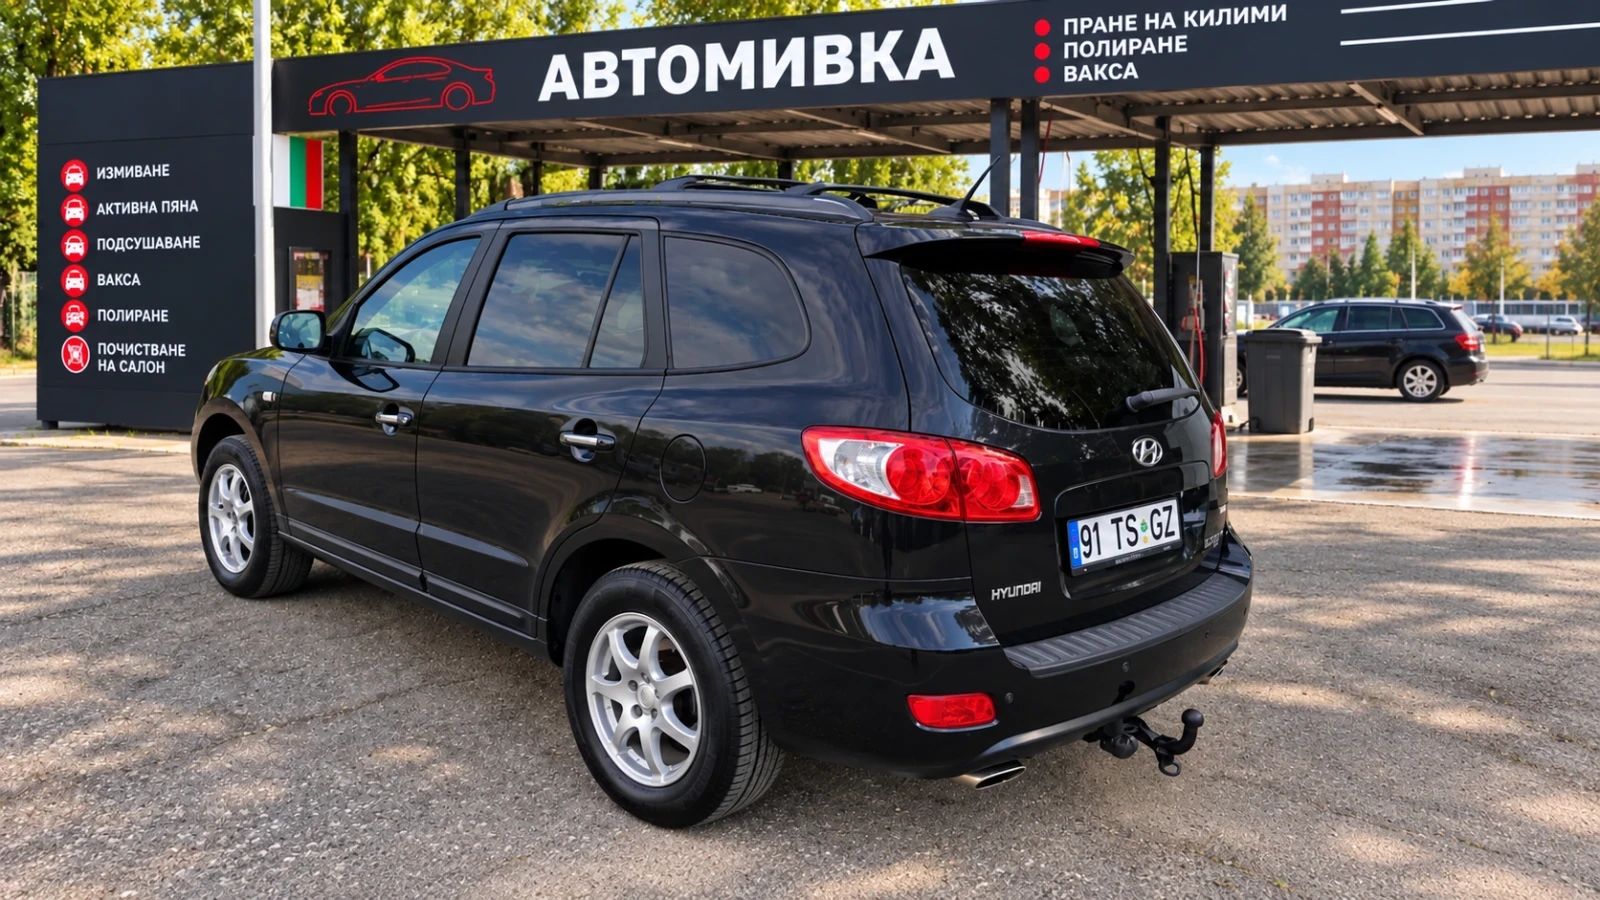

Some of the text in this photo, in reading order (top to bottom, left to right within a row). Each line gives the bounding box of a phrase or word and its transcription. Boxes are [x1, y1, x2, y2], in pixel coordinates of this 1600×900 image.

[1063, 4, 1288, 36] ПРАНЕ НА КИЛИМИ
[1063, 34, 1188, 60] ПОЛИРАНЕ
[537, 27, 956, 102] АВТОМИВКА
[1063, 61, 1139, 83] ВАКСА
[96, 163, 170, 180] ИЗМИВАНЕ
[96, 199, 199, 216] АКТИВНА ПЯНА
[96, 235, 201, 253] ПОДСУШАВАНЕ
[97, 272, 141, 287] ВАКСА
[97, 308, 169, 323] ПОЛИРАНЕ
[97, 342, 186, 357] ПОЧИСТВАНЕ
[97, 358, 165, 374] НА САЛОН
[1080, 521, 1101, 559] 91
[1110, 513, 1139, 550] TS
[1150, 504, 1176, 541] GZ
[991, 581, 1042, 601] HYUNDAI
